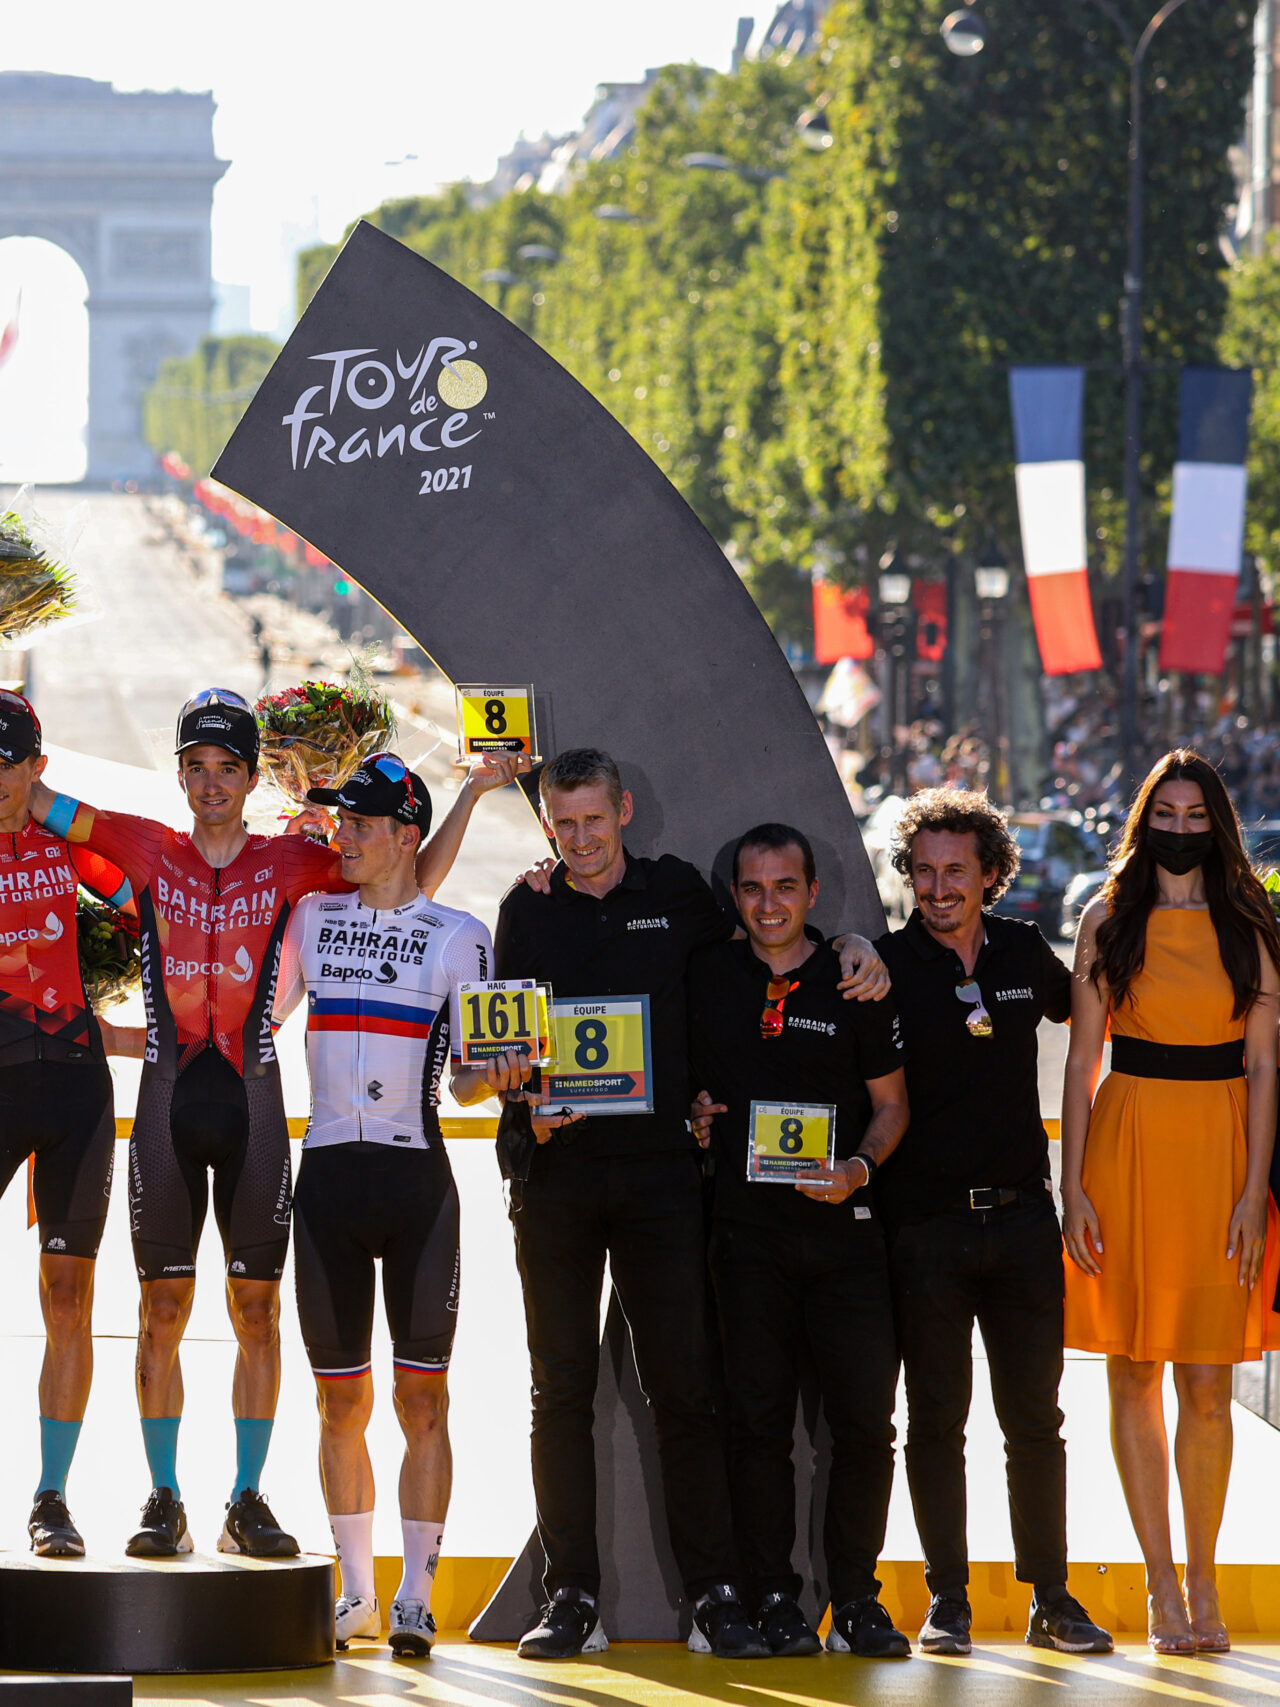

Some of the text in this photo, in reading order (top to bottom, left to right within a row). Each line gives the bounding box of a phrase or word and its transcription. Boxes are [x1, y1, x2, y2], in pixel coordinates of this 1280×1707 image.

[307, 336, 477, 416] TOUR
[410, 387, 439, 416] de
[483, 411, 496, 420] TM
[419, 464, 472, 495] 2021
[484, 689, 504, 697] ÉQUIPE
[485, 699, 507, 734] 8
[158, 876, 277, 922] BAHRAIN
[158, 902, 273, 934] VICTORIOUS
[627, 918, 660, 927] BAHRAIN
[317, 944, 424, 965] VICTORIOUS
[319, 928, 427, 955] BAHRAIN
[165, 956, 224, 981] Bapco
[321, 963, 372, 982] Bapco
[141, 932, 159, 1064] BAHRAIN
[487, 982, 507, 990] HAIG
[995, 988, 1027, 998] BAHRAIN
[258, 940, 282, 1064] BAHRAIN
[574, 1005, 607, 1016] ÉQUIPE
[467, 992, 531, 1040] 161
[788, 1016, 827, 1028] BAHRAIN
[574, 1018, 609, 1070] 8
[429, 1022, 450, 1107] BAHRAIN
[563, 1079, 623, 1089] NAMEDSPORT
[780, 1107, 804, 1116] ÉQUIPE
[778, 1117, 803, 1155] 8
[130, 1142, 144, 1194] BUSINESS
[769, 1159, 812, 1168] NAMEDSPORT
[276, 1159, 290, 1210] BUSINESS
[163, 1264, 196, 1273] MERID
